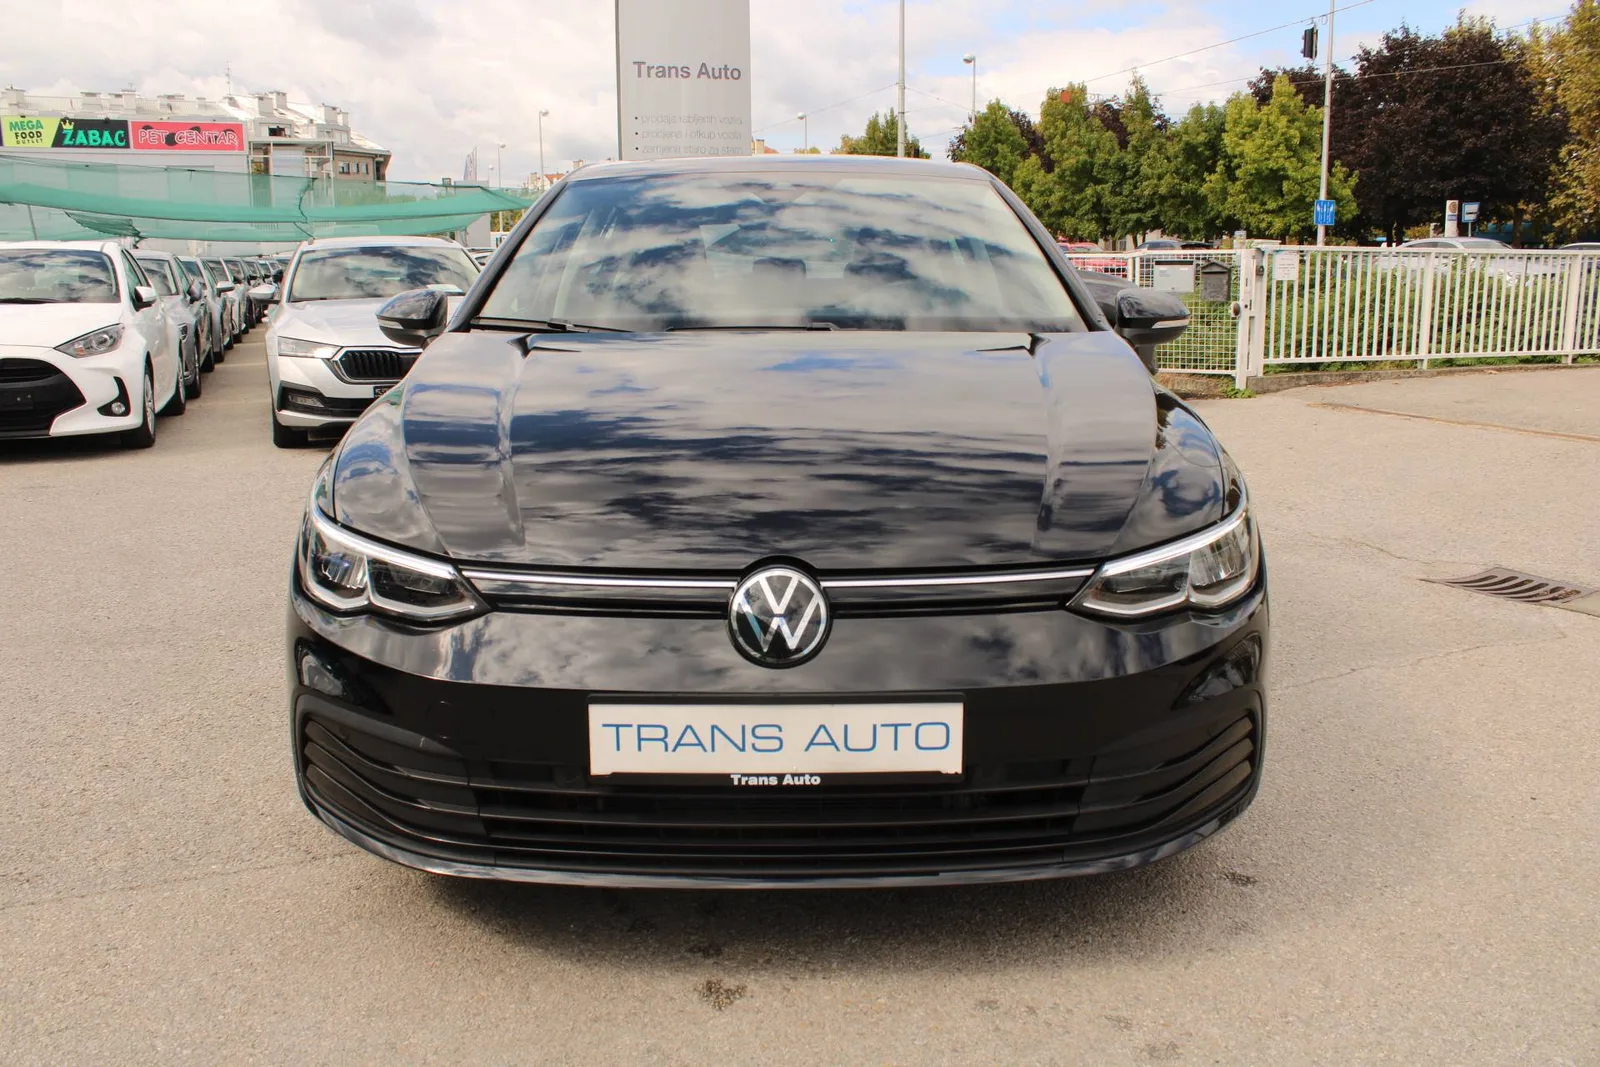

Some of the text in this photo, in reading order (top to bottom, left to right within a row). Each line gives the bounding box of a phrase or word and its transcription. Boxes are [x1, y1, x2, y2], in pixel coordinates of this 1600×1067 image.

[632, 61, 742, 80] Trans Auto
[9, 119, 44, 132] MEGA
[14, 131, 42, 139] FOOD
[138, 129, 239, 146] PET CENTAR
[689, 129, 716, 141] otkup
[601, 721, 951, 753] TRANS AUTO
[730, 774, 821, 786] Trans Auto
